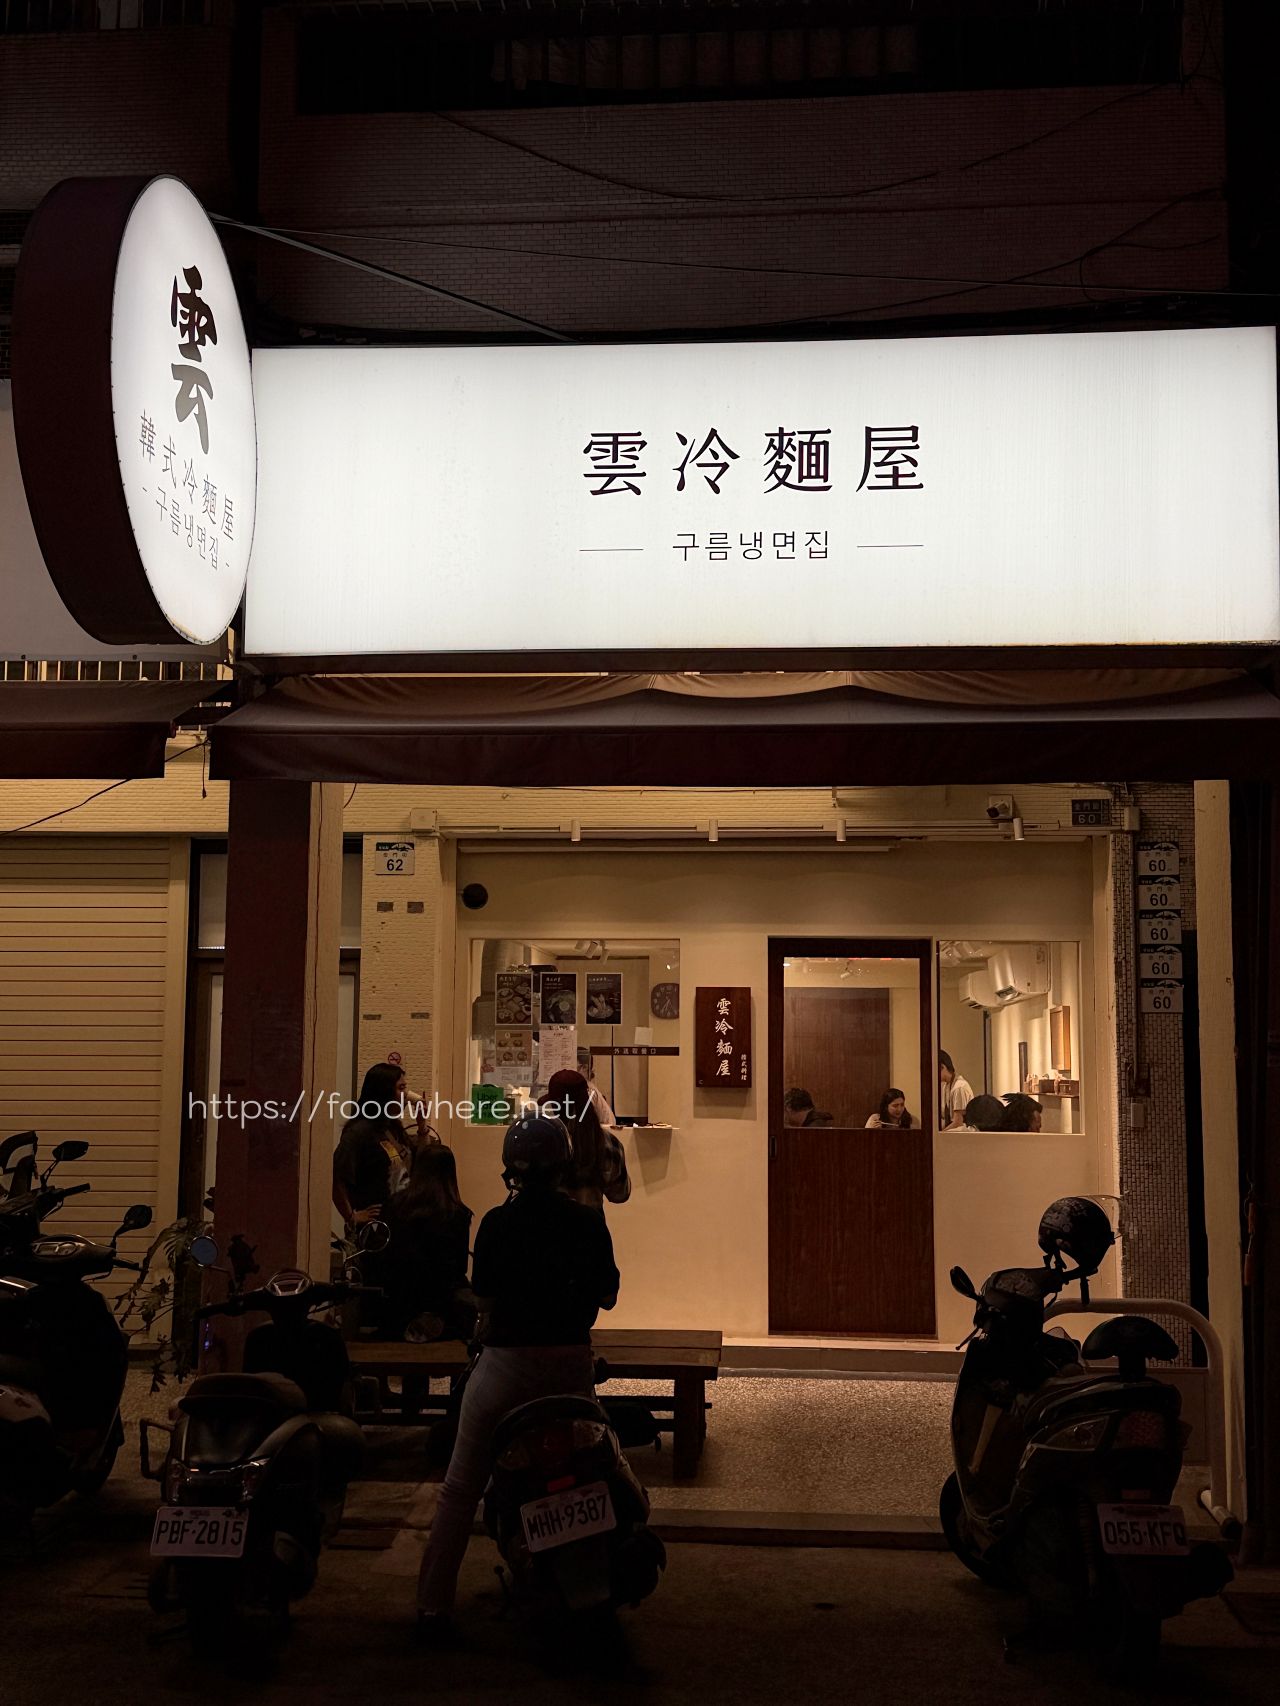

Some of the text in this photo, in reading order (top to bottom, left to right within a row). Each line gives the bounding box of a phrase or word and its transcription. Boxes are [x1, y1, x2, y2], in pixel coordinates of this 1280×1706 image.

[172, 264, 217, 455] 雲
[582, 424, 924, 496] 雲冷麵屋
[139, 409, 234, 541] 韓式冷麵屋
[156, 486, 219, 571] 구름냉면집
[672, 530, 829, 562] 구름냉면집
[1078, 813, 1096, 825] 60
[386, 858, 404, 871] 62
[1149, 859, 1166, 872] 60
[1150, 893, 1168, 906] 60
[1151, 927, 1169, 941] 60
[1152, 962, 1170, 975] 60
[1153, 996, 1172, 1009] 60
[714, 997, 734, 1077] 雲冷麵屋
